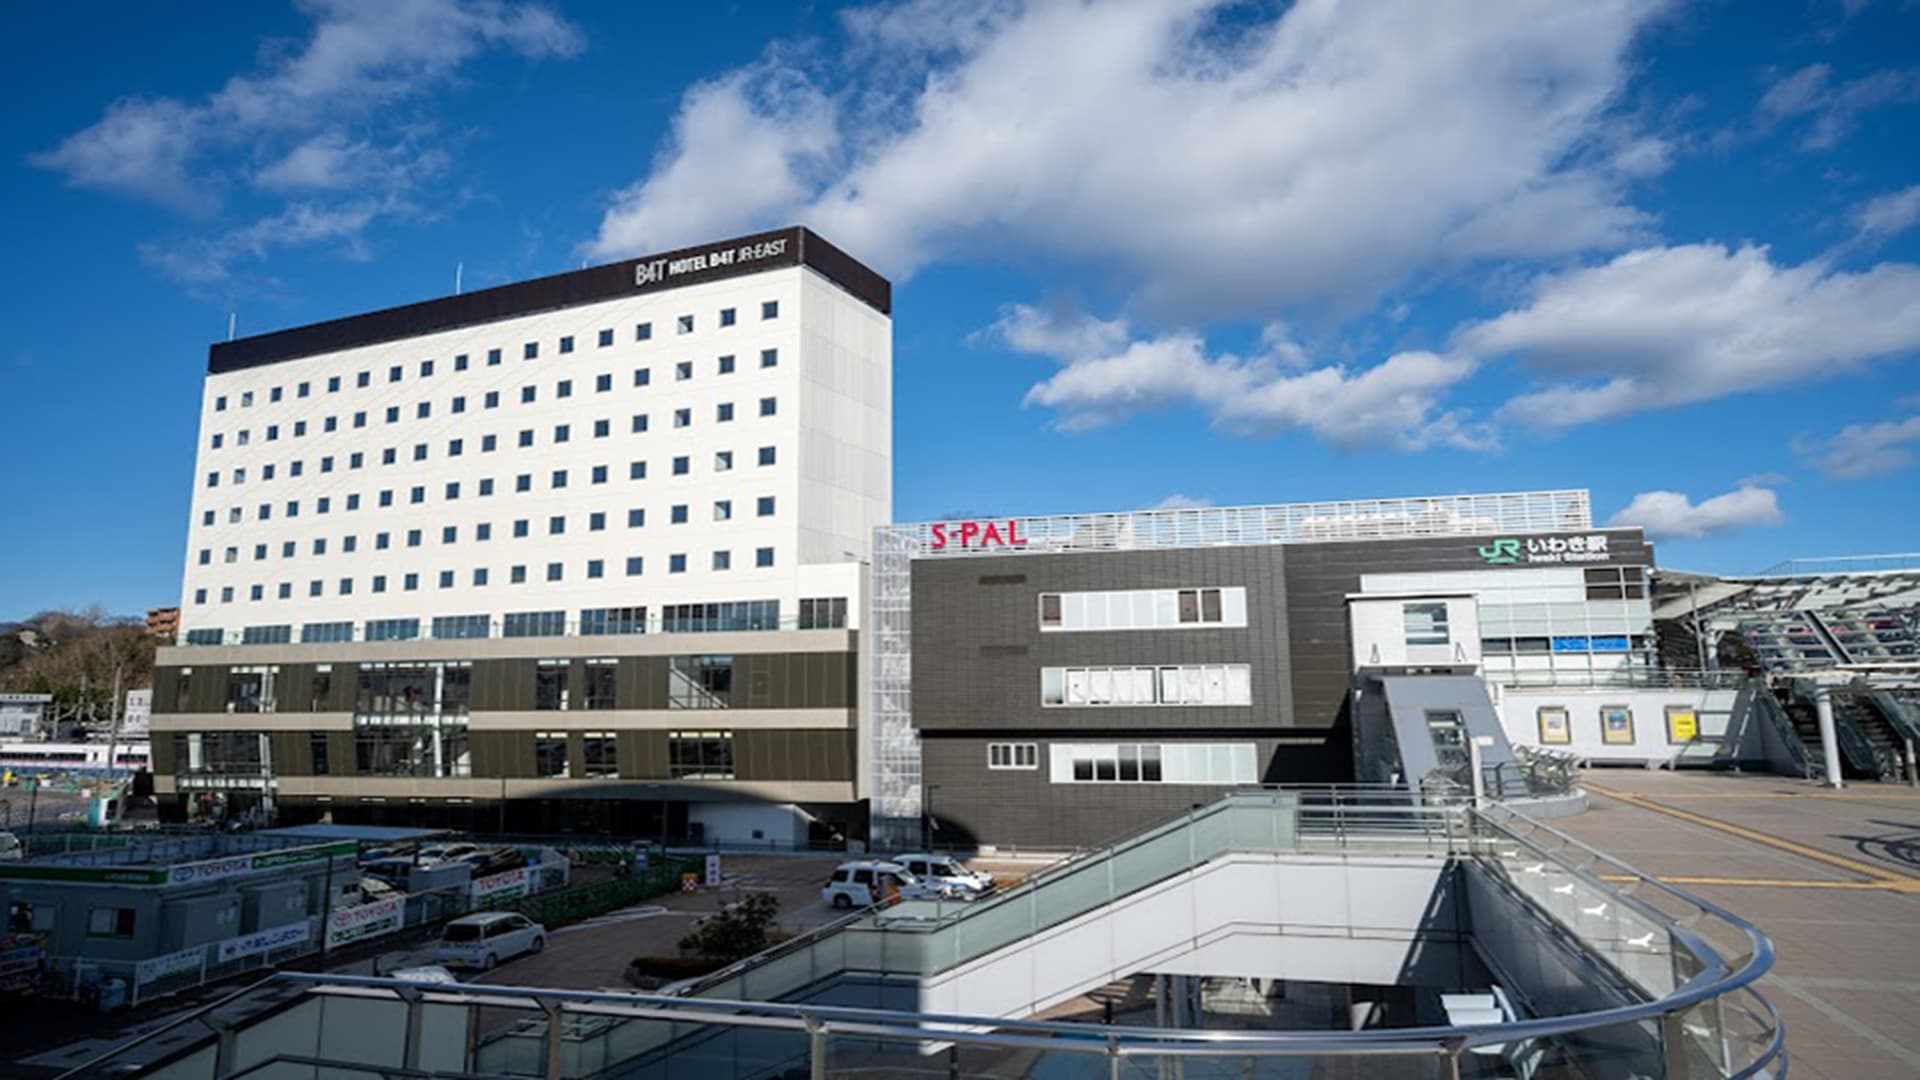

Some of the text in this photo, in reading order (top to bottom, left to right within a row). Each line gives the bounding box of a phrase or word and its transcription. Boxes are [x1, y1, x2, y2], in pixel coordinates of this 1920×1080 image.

[669, 256, 707, 275] HOTEL
[709, 249, 736, 267] B4T
[1479, 539, 1520, 560] JR
[1527, 535, 1608, 553] いわき駅
[1528, 552, 1610, 563] Iwaki Station
[195, 860, 248, 878] TOYOTA
[479, 868, 524, 889] TOYOTA
[353, 901, 397, 922] TOYOTA
